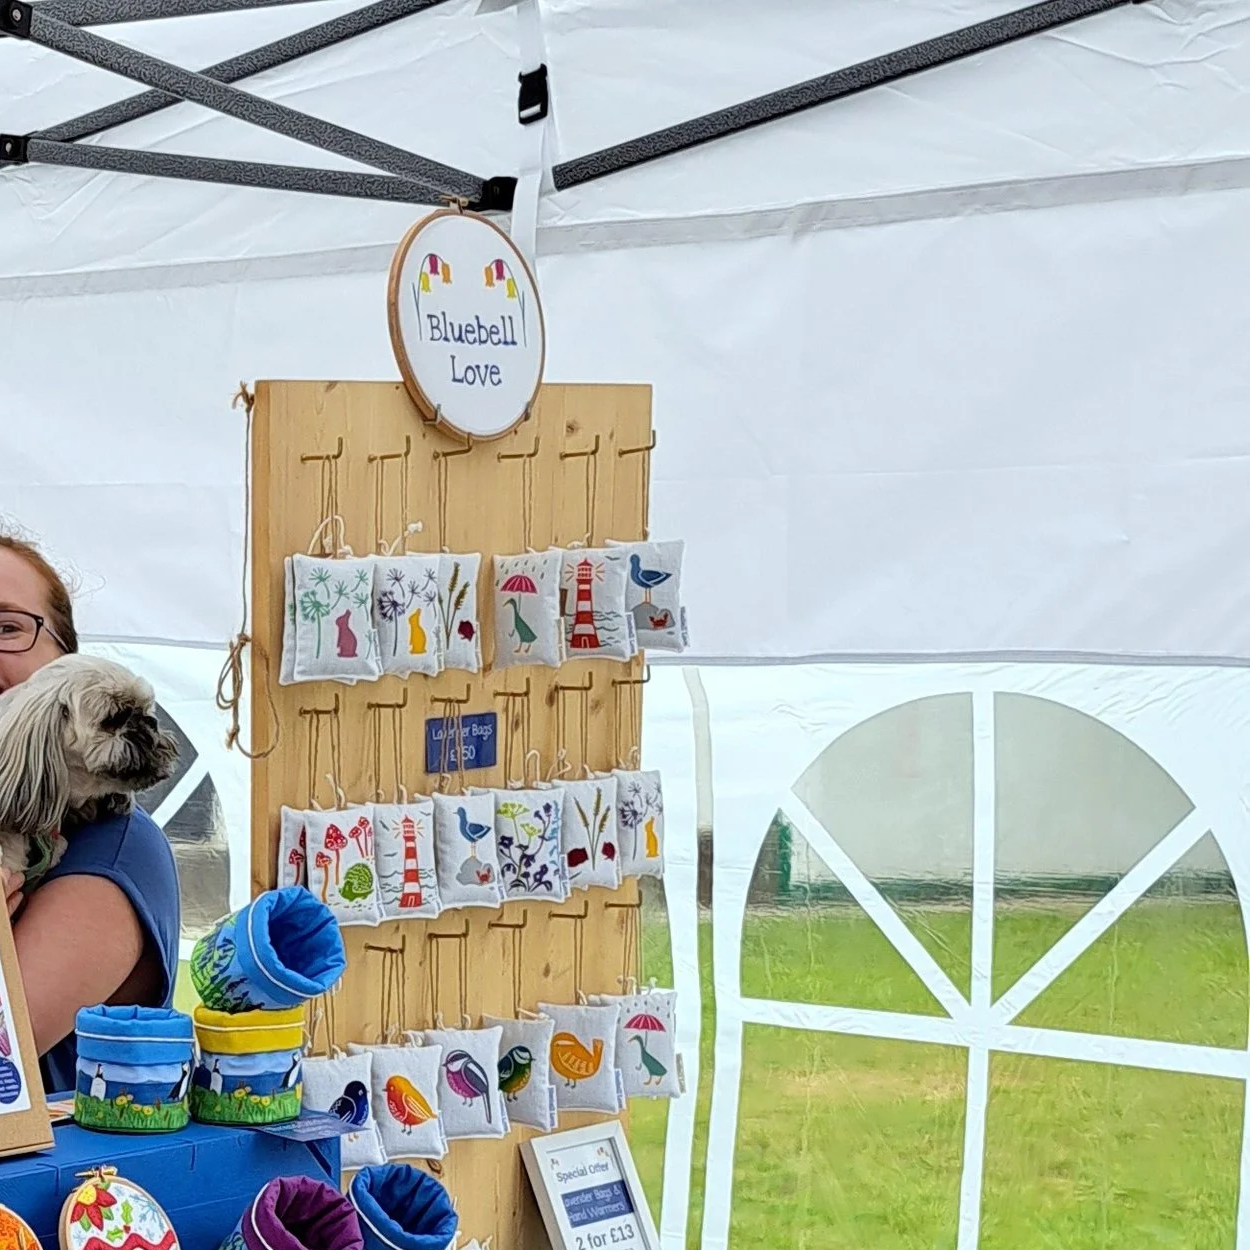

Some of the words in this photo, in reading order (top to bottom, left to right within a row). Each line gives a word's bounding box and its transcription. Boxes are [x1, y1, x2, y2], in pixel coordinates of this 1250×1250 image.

[427, 311, 517, 346] Bluebell
[450, 355, 502, 388] Love
[472, 724, 492, 740] Bags
[557, 1167, 587, 1183] Special
[589, 1162, 609, 1173] Offer
[565, 1190, 592, 1207] avender
[594, 1188, 612, 1201] Bags
[588, 1202, 626, 1217] Warmers
[588, 1232, 607, 1249] for
[611, 1224, 635, 1243] £13
